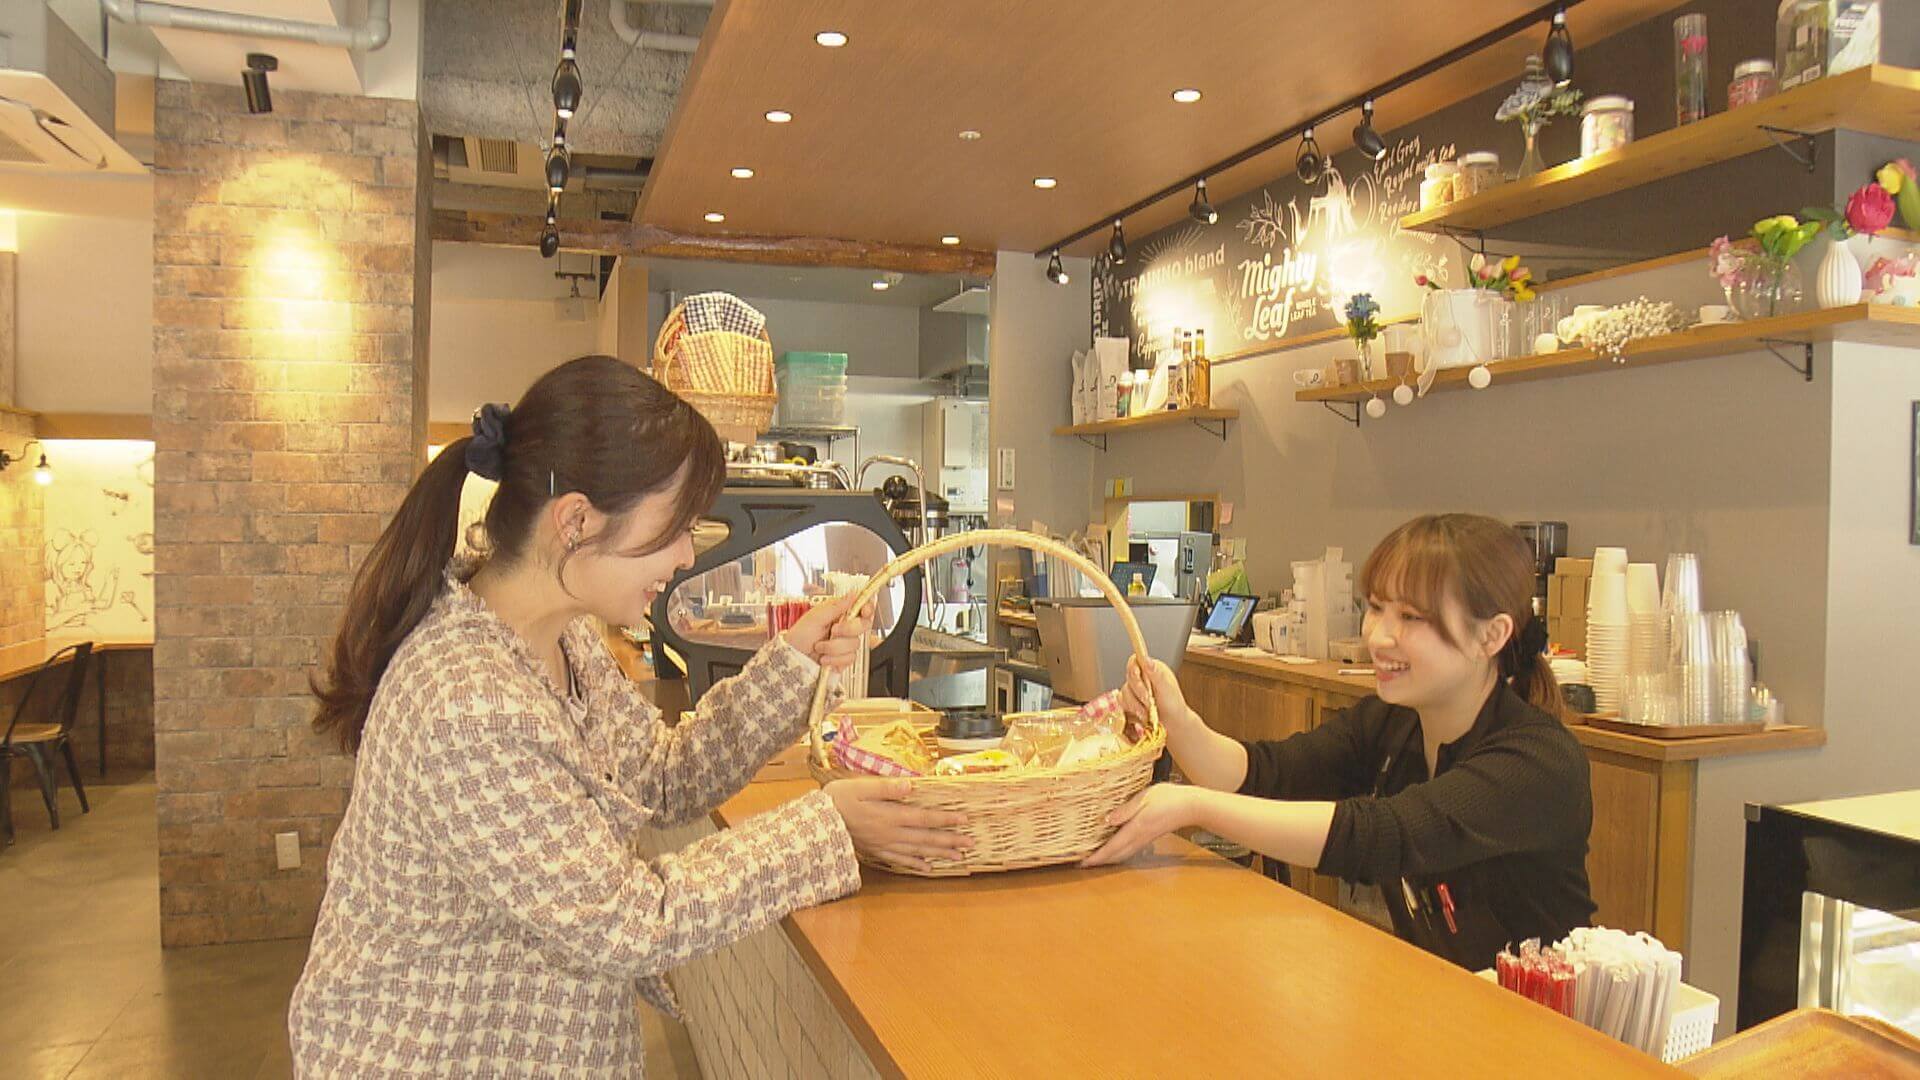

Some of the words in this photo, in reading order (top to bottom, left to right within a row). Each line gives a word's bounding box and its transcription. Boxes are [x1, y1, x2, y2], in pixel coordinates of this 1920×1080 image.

[1397, 135, 1420, 163] Grey
[1384, 158, 1415, 198] Royal
[1185, 242, 1226, 277] blend
[1237, 247, 1318, 301] Mighty
[1244, 287, 1296, 340] Leaf
